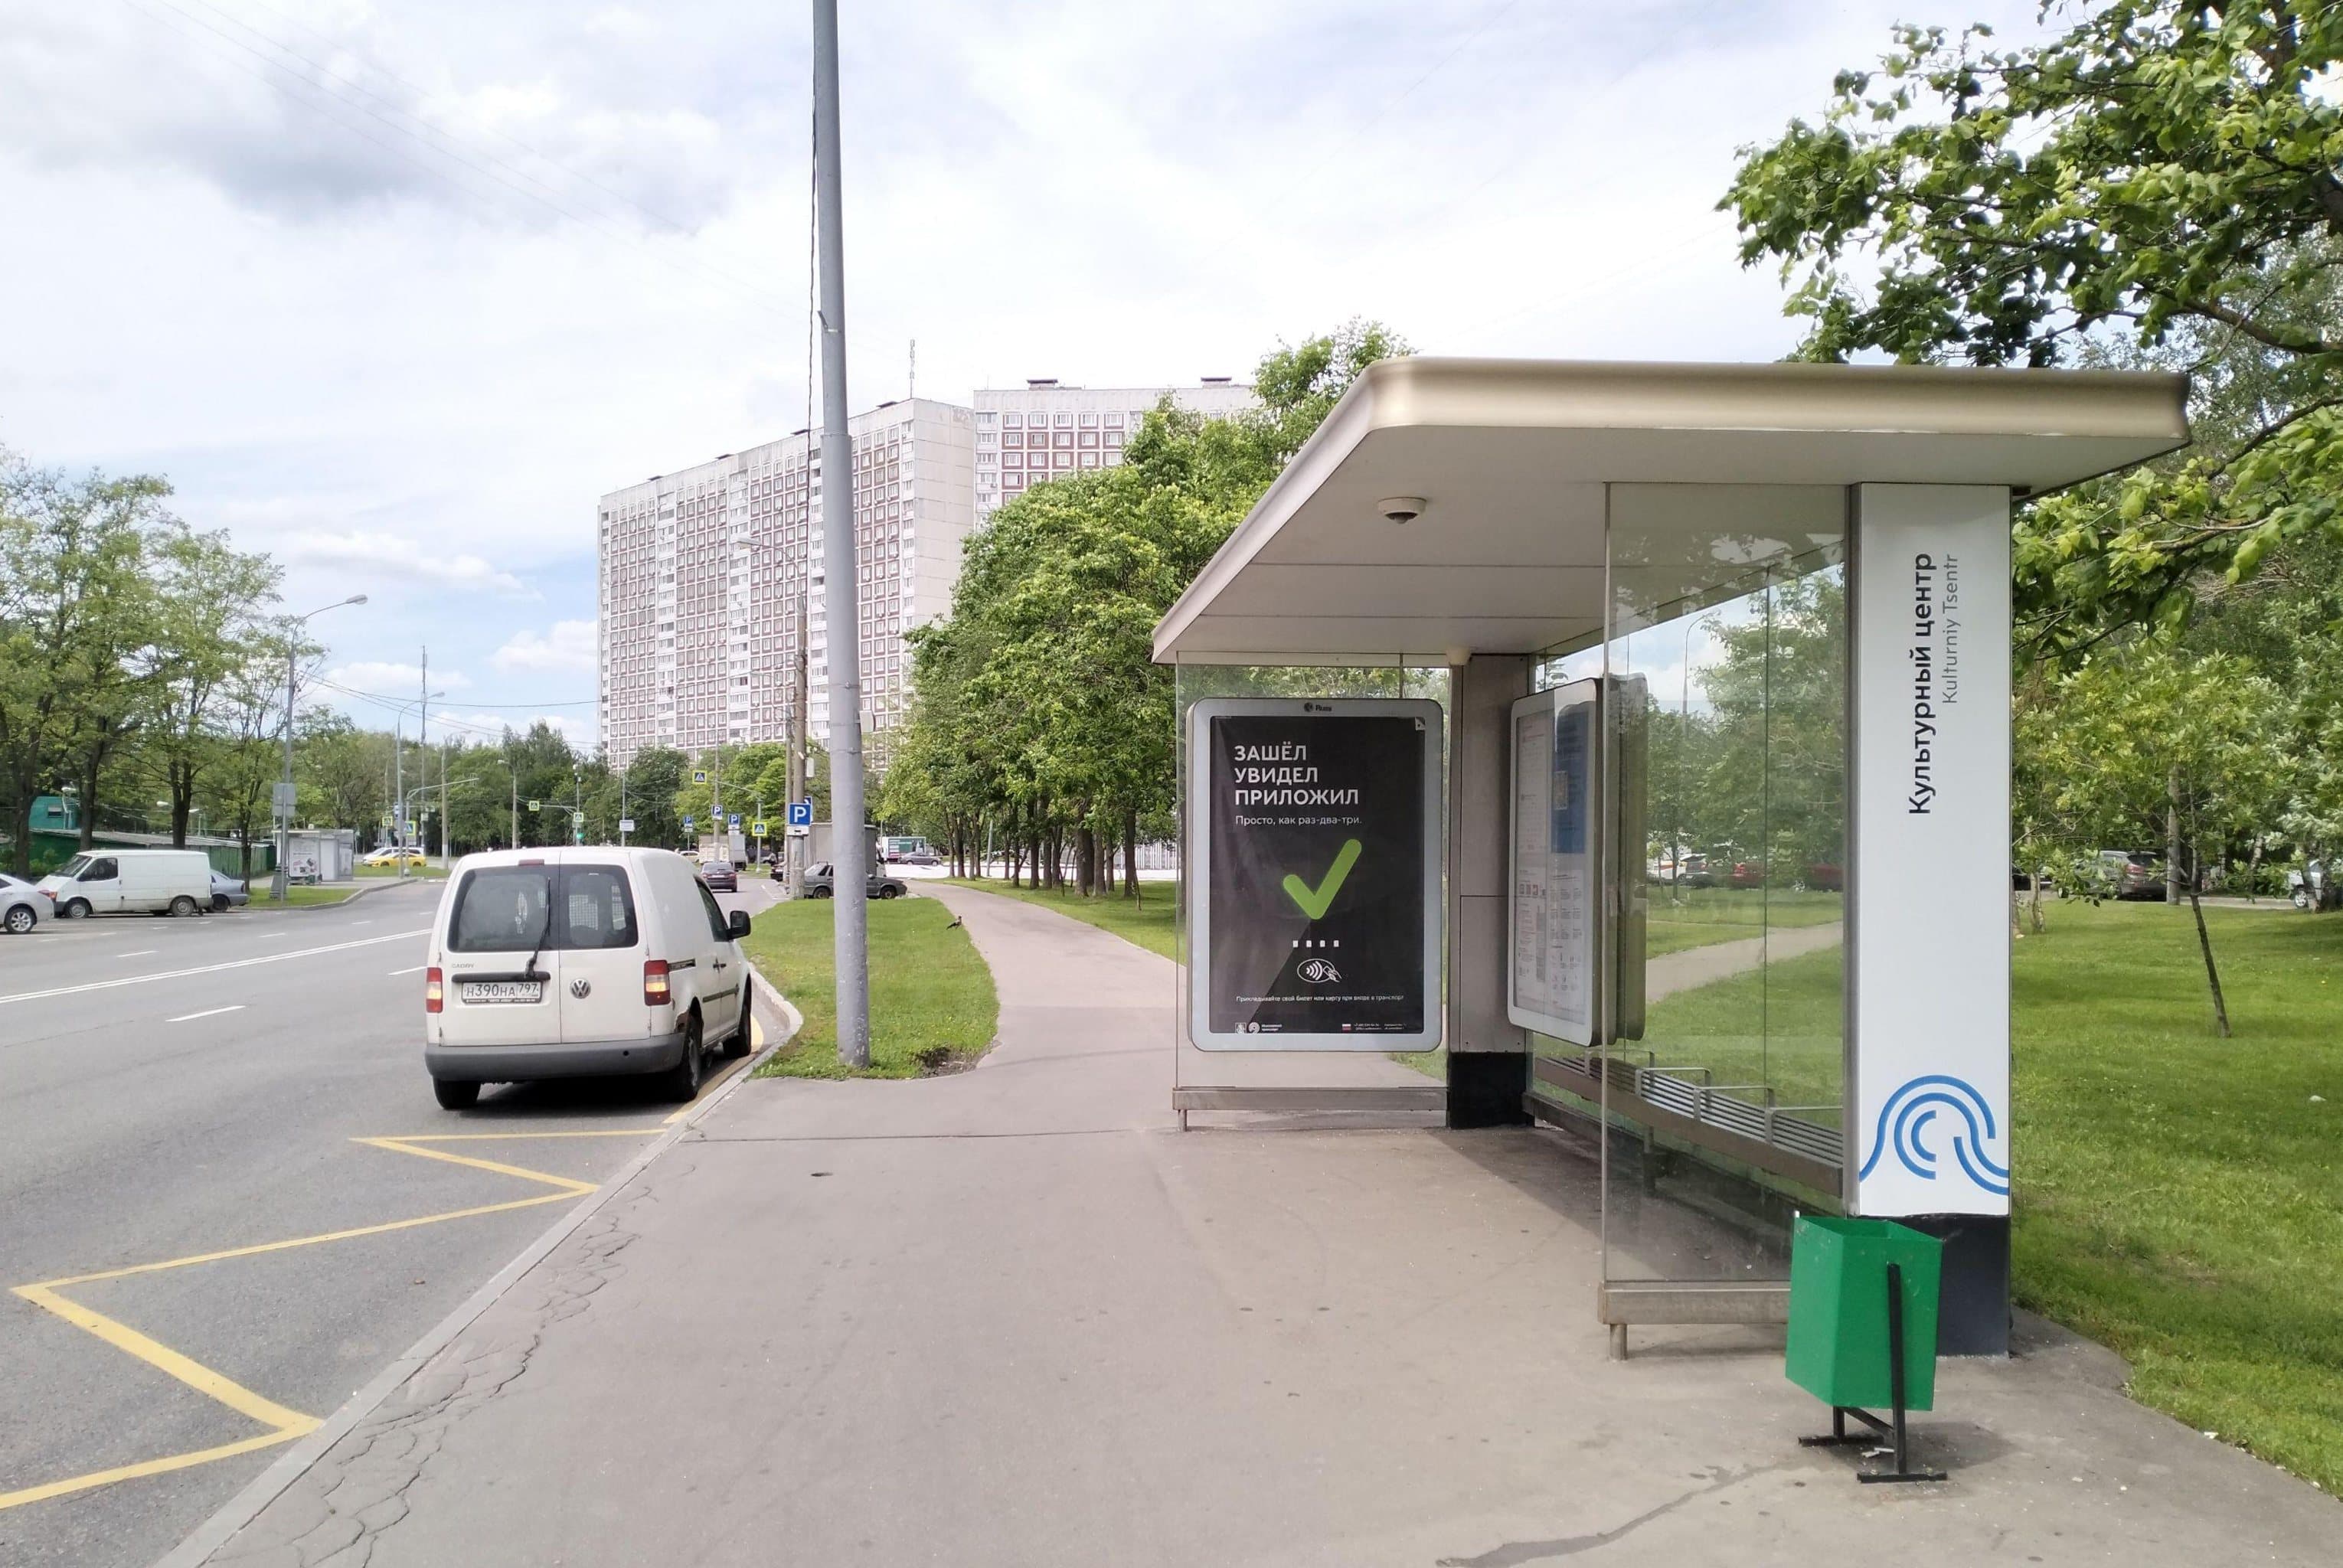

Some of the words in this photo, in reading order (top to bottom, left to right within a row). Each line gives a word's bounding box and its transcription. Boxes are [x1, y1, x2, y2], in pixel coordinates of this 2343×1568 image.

[1943, 554, 1958, 613] Tsentr
[1915, 553, 1936, 637] центр
[1942, 618, 1961, 704] Kulturniy
[1909, 646, 1936, 814] Культурный
[1234, 741, 1306, 761] ЗАШЁЛ
[1234, 767, 1318, 786] УВИДЕЛ
[1235, 789, 1358, 805] ПРИЛОЖИЛ
[795, 806, 806, 823] P
[1236, 815, 1276, 826] Просто,
